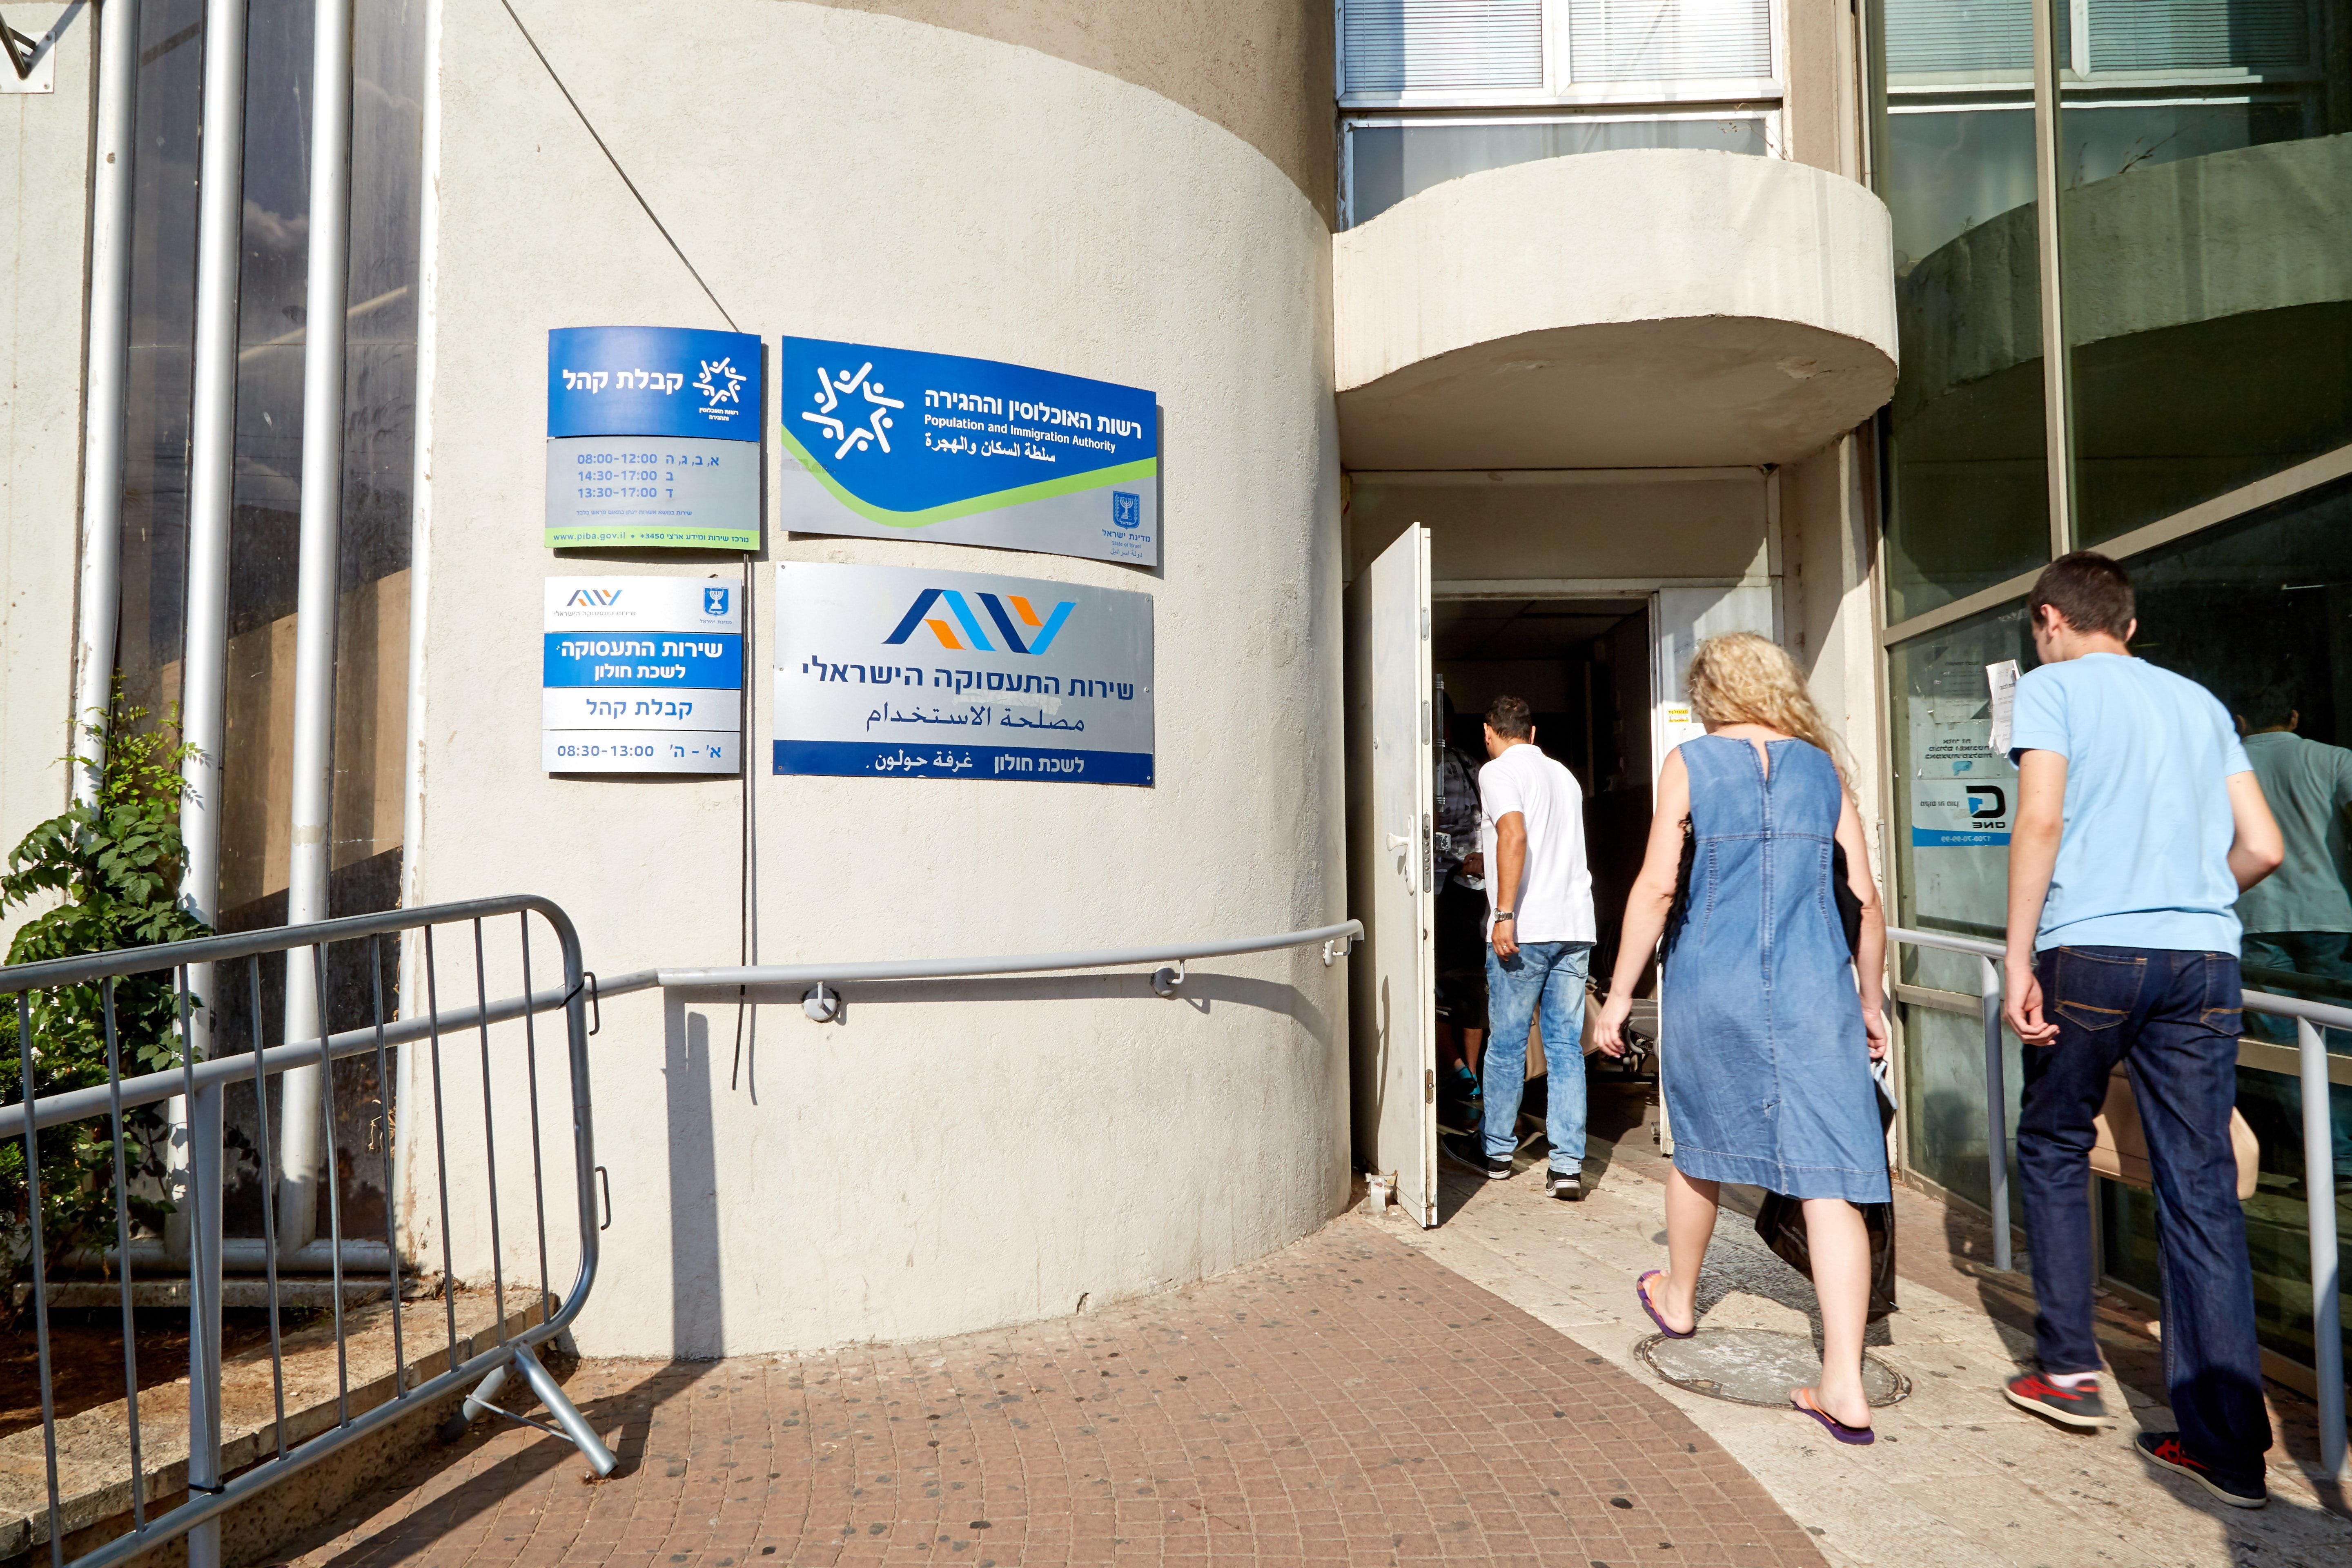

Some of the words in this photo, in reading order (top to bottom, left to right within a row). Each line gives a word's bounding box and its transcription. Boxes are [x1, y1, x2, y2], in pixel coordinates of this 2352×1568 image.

[563, 369, 608, 394] קהל
[616, 368, 684, 395] קבלת
[925, 389, 1002, 414] וההגירה
[1009, 400, 1091, 430] האוכלוסין
[924, 414, 984, 431] Population
[988, 423, 1007, 434] and
[1011, 425, 1069, 444] Immigration
[1072, 437, 1116, 453] Authority
[1097, 416, 1141, 439] רשות
[925, 432, 976, 454] والهجرة
[981, 440, 1020, 457] السكان
[577, 454, 657, 464] 08:00-12:00
[666, 455, 674, 465] ה
[1025, 445, 1055, 462] سلطة
[578, 471, 657, 481] 14:30-17:00
[666, 472, 674, 481] ב
[578, 488, 657, 498] 13:30-17:00
[666, 489, 673, 498] ד
[553, 532, 625, 541] www.piba.gov.il
[1102, 529, 1125, 538] ישראל
[1129, 534, 1150, 542] מדינת
[1131, 550, 1143, 558] دولة
[561, 641, 654, 660] התעסוקה
[662, 642, 723, 658] שירות
[595, 664, 632, 681] חולון
[637, 664, 686, 679] לשכת
[802, 655, 922, 686] הישראלי
[934, 668, 1060, 695] התעסוקה
[1068, 678, 1134, 700] שירות
[586, 699, 626, 719] קהל
[635, 699, 693, 720] קבלת
[867, 702, 991, 732] الاستخدام
[1000, 704, 1084, 732] مصلحة
[558, 745, 653, 757] 08:30-13:00
[875, 749, 928, 772] حولون
[933, 753, 973, 773] غرفة
[994, 754, 1032, 774] חולון
[1038, 755, 1084, 773] לשכת
